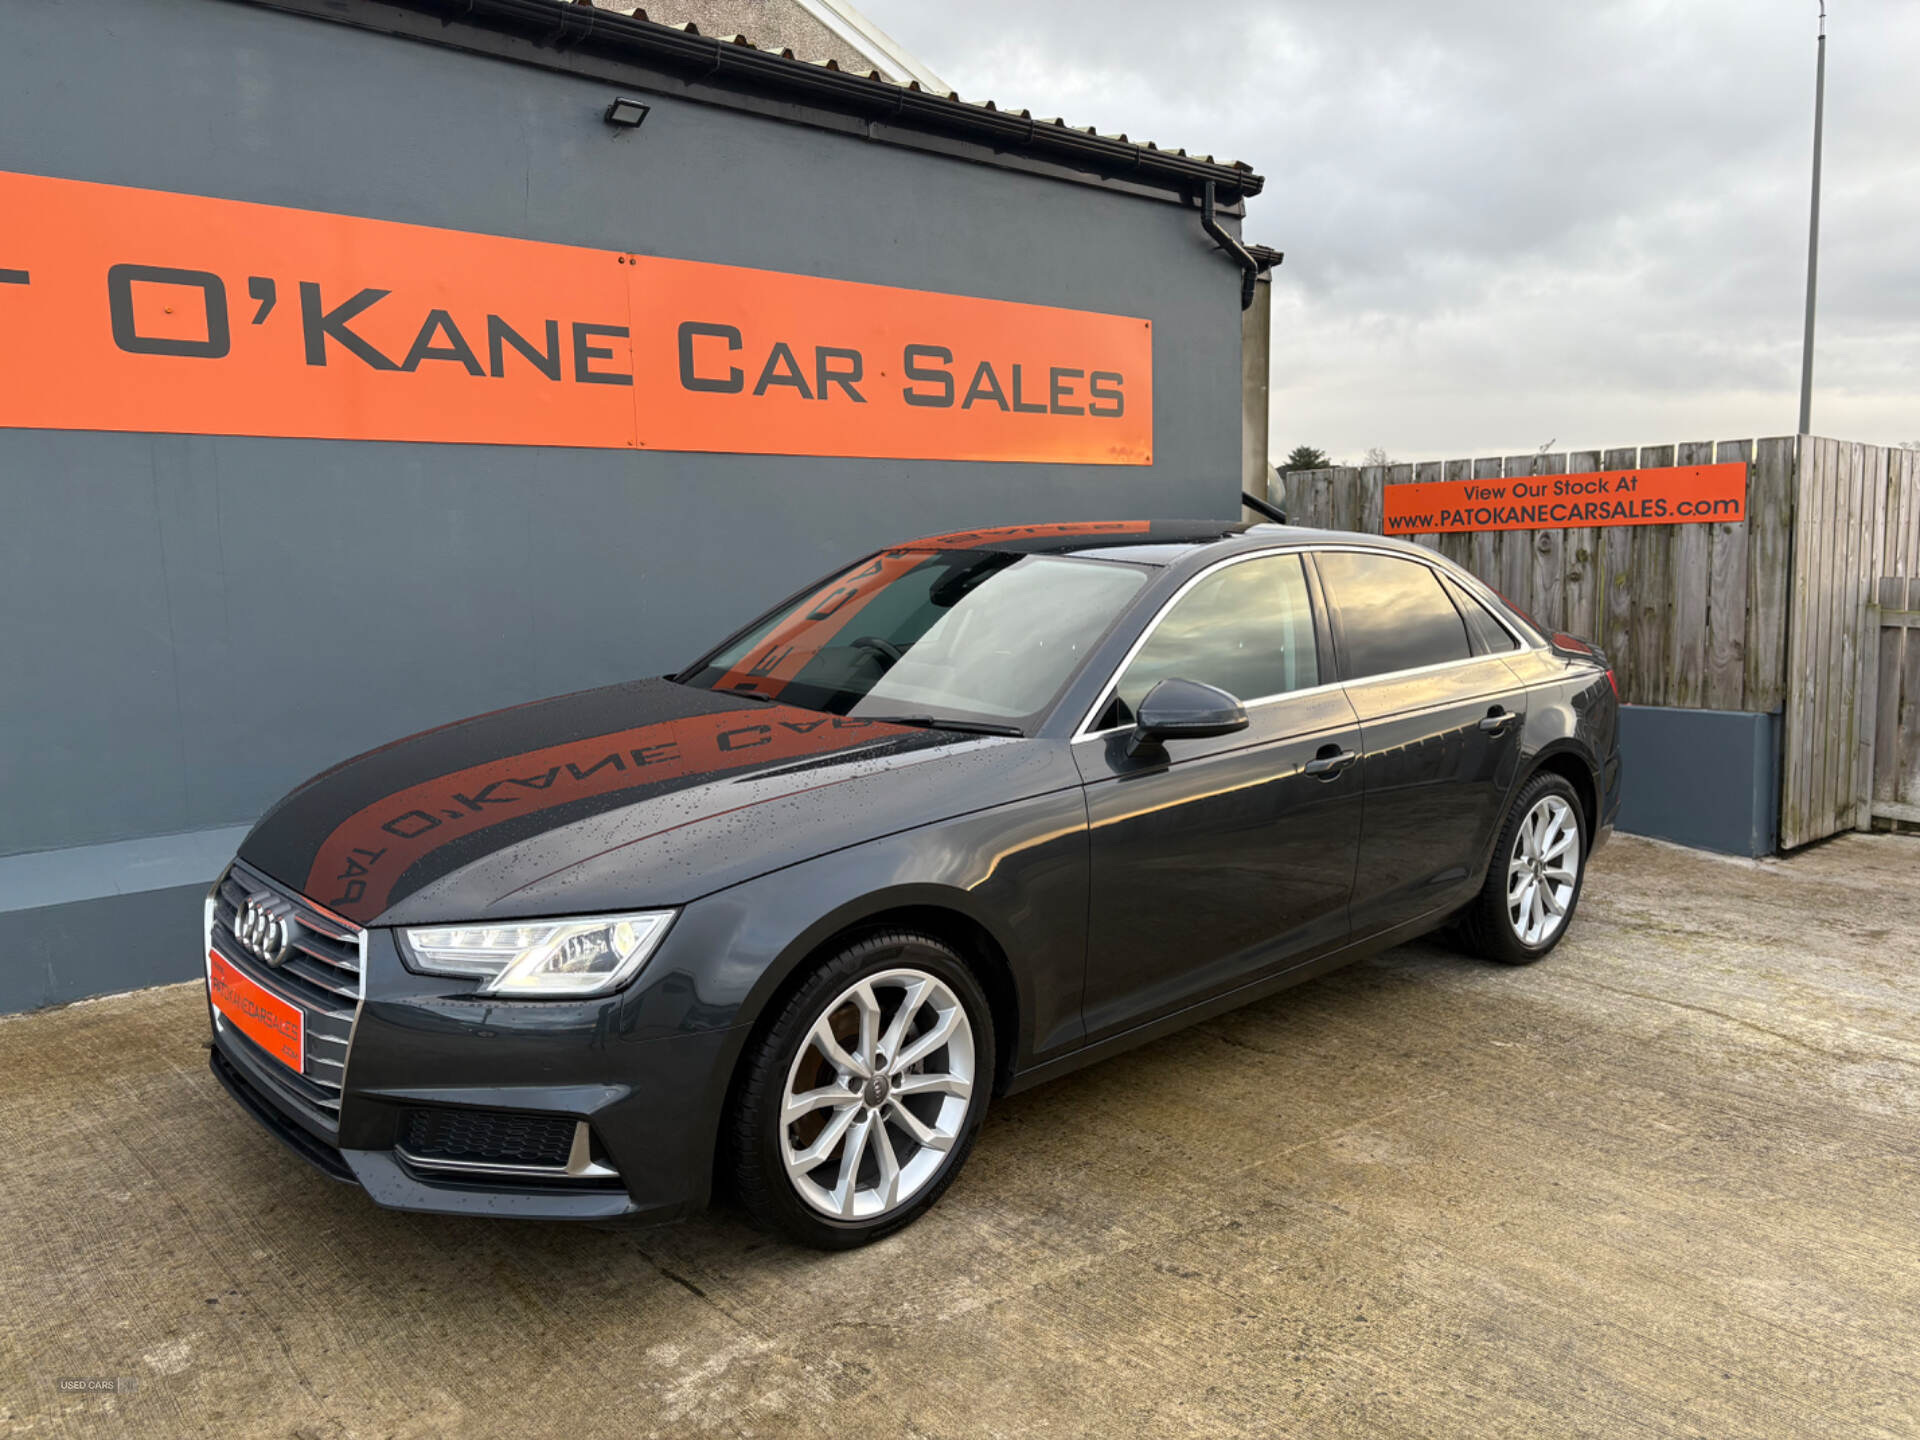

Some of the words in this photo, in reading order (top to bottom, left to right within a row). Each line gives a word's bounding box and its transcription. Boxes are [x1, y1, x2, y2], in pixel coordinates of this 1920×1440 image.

[107, 263, 634, 387] O'KANE
[677, 320, 868, 404] CAR
[903, 343, 1124, 418] SALES
[1464, 484, 1505, 501] View
[1512, 481, 1547, 498] Our
[1553, 477, 1608, 496] Stock
[1615, 476, 1638, 493] At
[1388, 498, 1740, 528] www.PATOKANECARSALES.com
